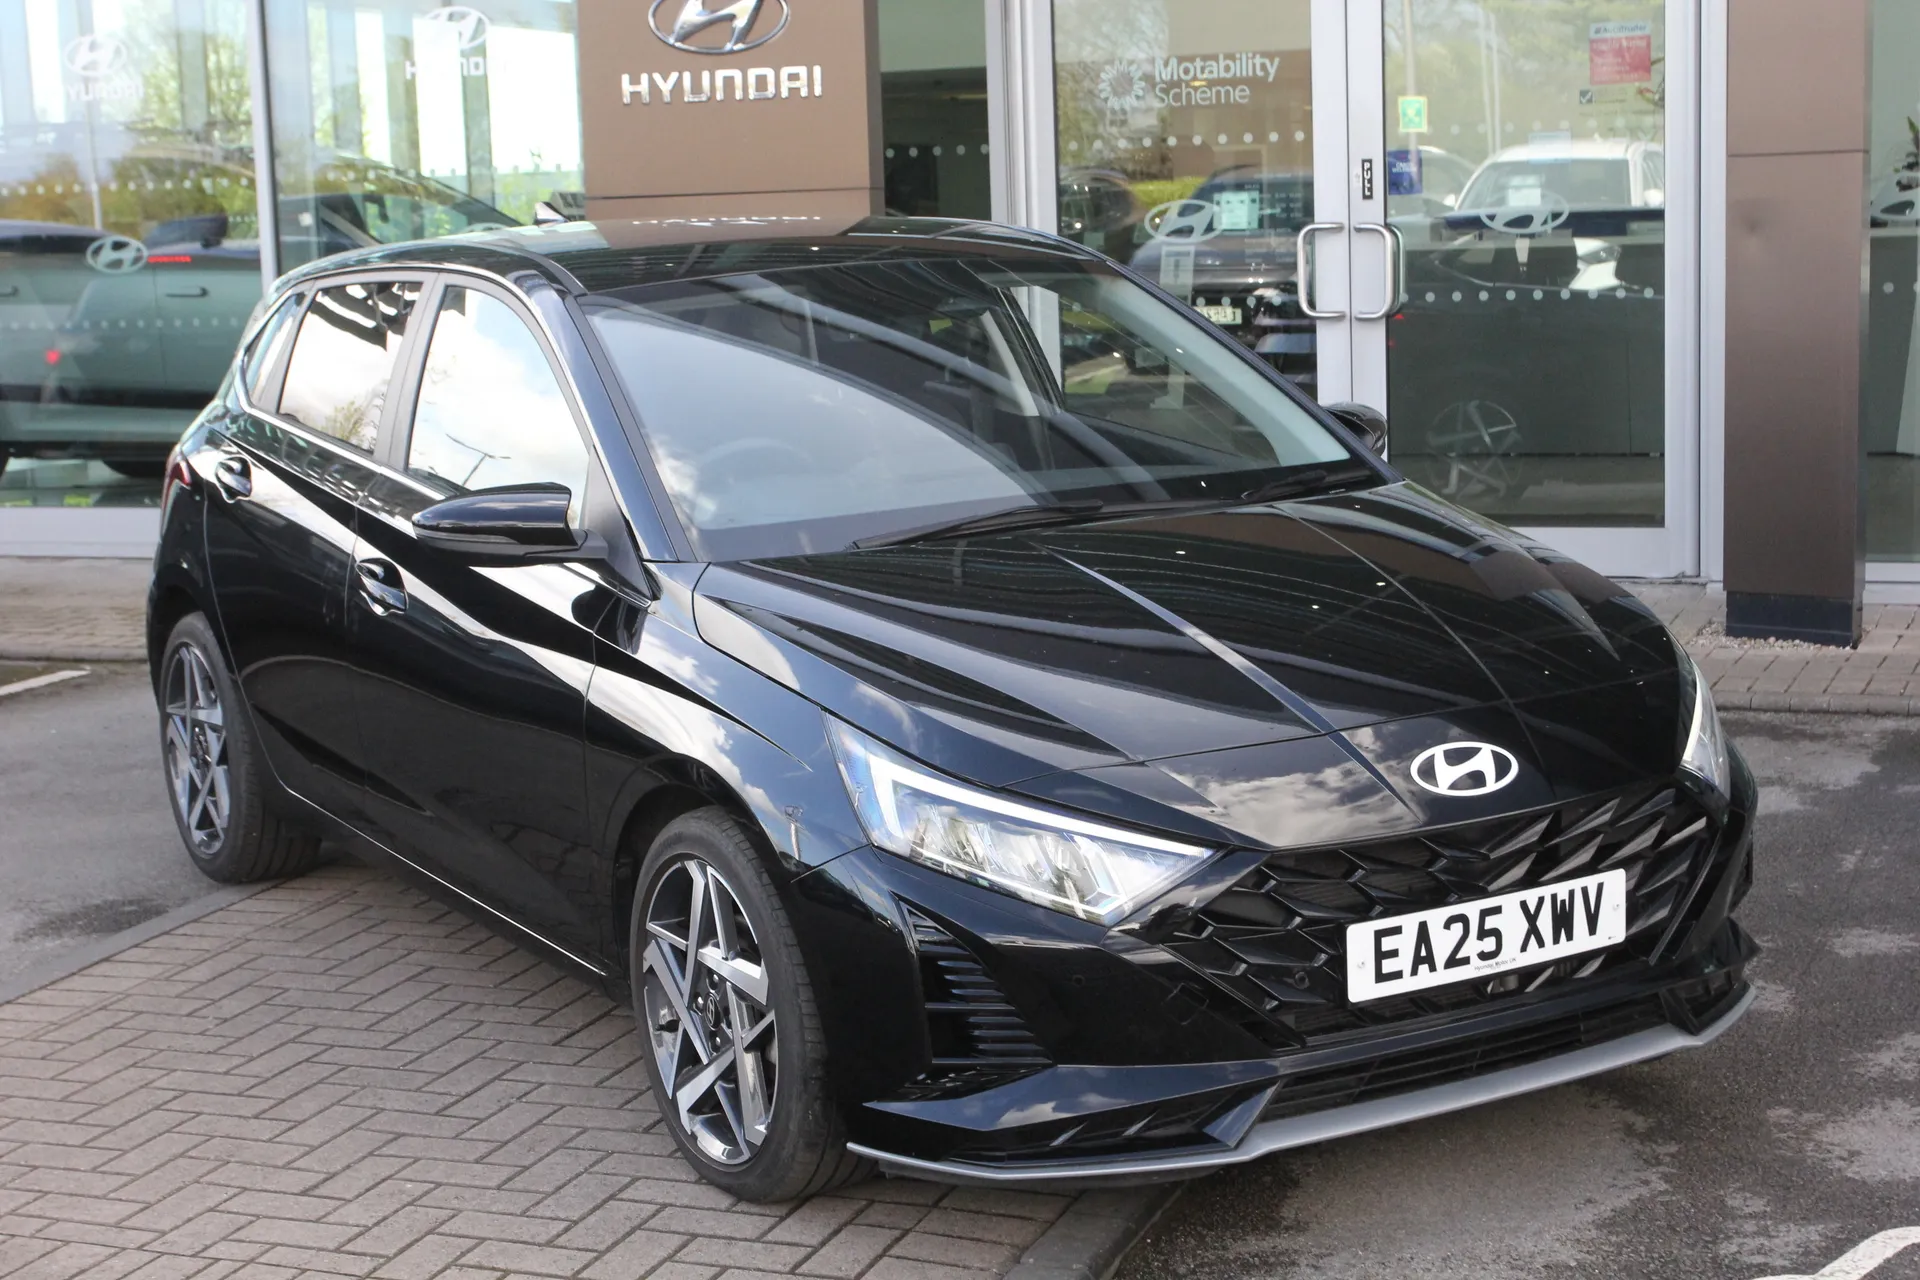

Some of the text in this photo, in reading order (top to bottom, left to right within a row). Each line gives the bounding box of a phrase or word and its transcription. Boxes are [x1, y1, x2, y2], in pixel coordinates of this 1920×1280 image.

[1154, 52, 1280, 82] Motability
[621, 64, 822, 106] HYUNDAI
[1155, 82, 1250, 107] Scheme
[1363, 162, 1371, 196] PULL
[1374, 881, 1605, 984] EA25 XWV
